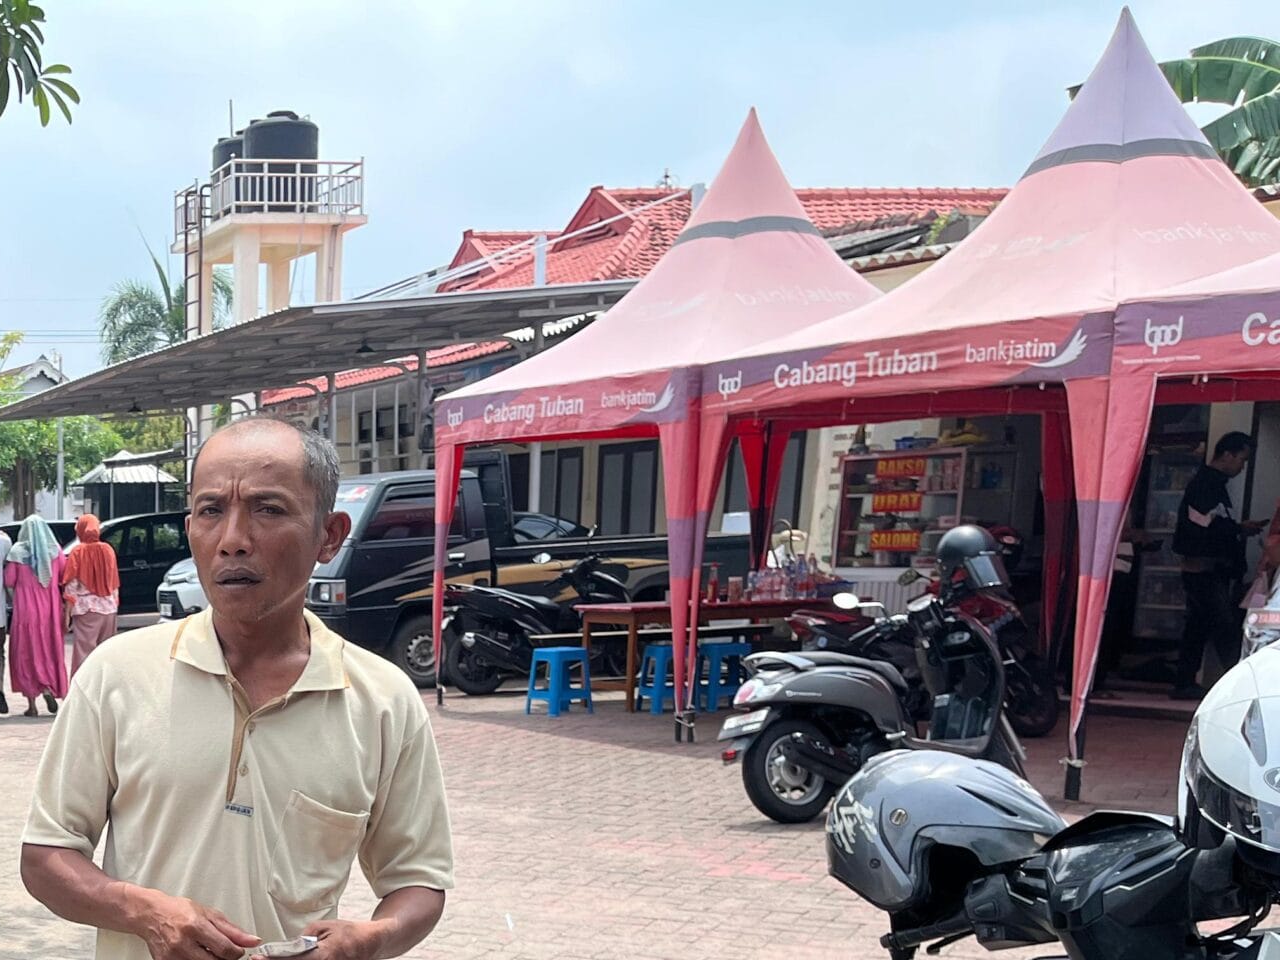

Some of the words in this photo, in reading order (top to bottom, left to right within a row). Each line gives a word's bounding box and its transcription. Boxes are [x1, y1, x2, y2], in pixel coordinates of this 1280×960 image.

[965, 339, 1057, 366] bankjatim
[773, 359, 857, 389] Cabang
[863, 348, 938, 378] Tuban
[483, 402, 536, 426] Cabang
[539, 395, 585, 417] Tuban
[601, 390, 656, 411] bankjatim
[874, 493, 920, 509] URAT
